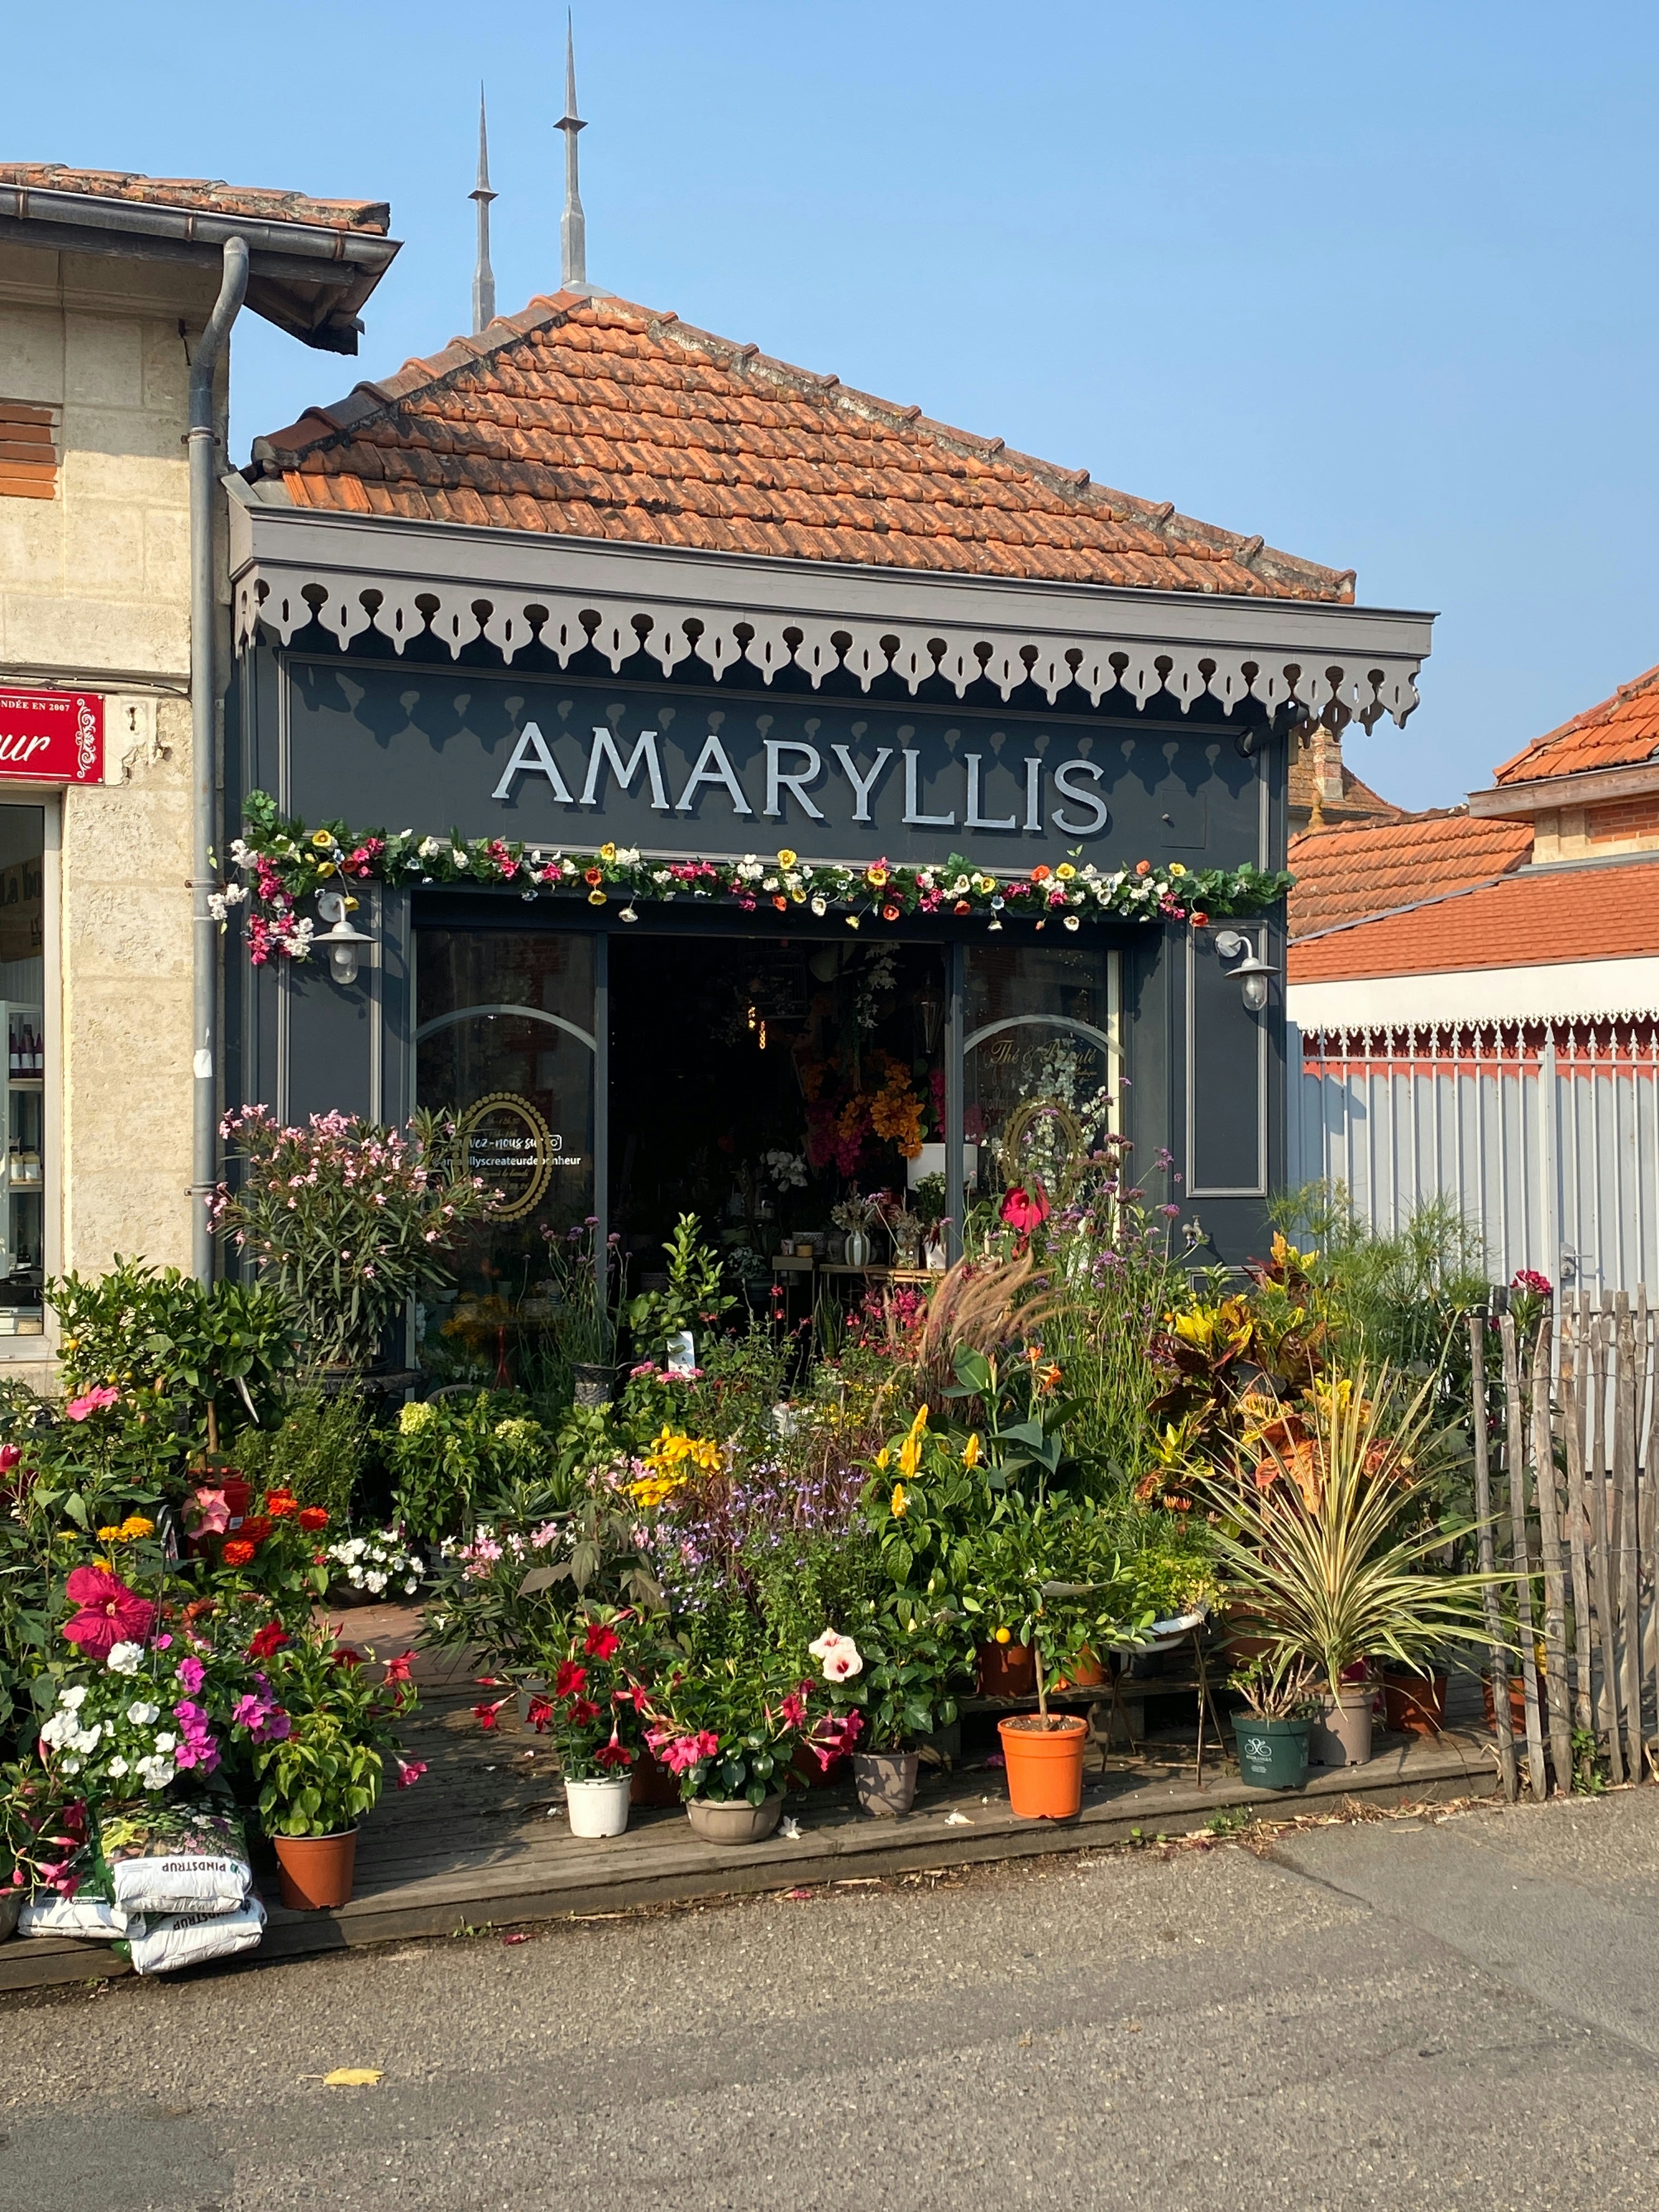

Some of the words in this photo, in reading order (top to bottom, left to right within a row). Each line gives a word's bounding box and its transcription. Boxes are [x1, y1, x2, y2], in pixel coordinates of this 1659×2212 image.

[32, 702, 46, 710] EN
[49, 703, 70, 712] 2007
[0, 734, 50, 761] ur
[492, 721, 1108, 835] AMARYLLIS
[991, 1040, 1019, 1065] Thé
[1020, 1045, 1039, 1074] &
[1039, 1040, 1097, 1065] Buté
[524, 1138, 544, 1149] su
[162, 1862, 226, 1872] PINDSTRUP
